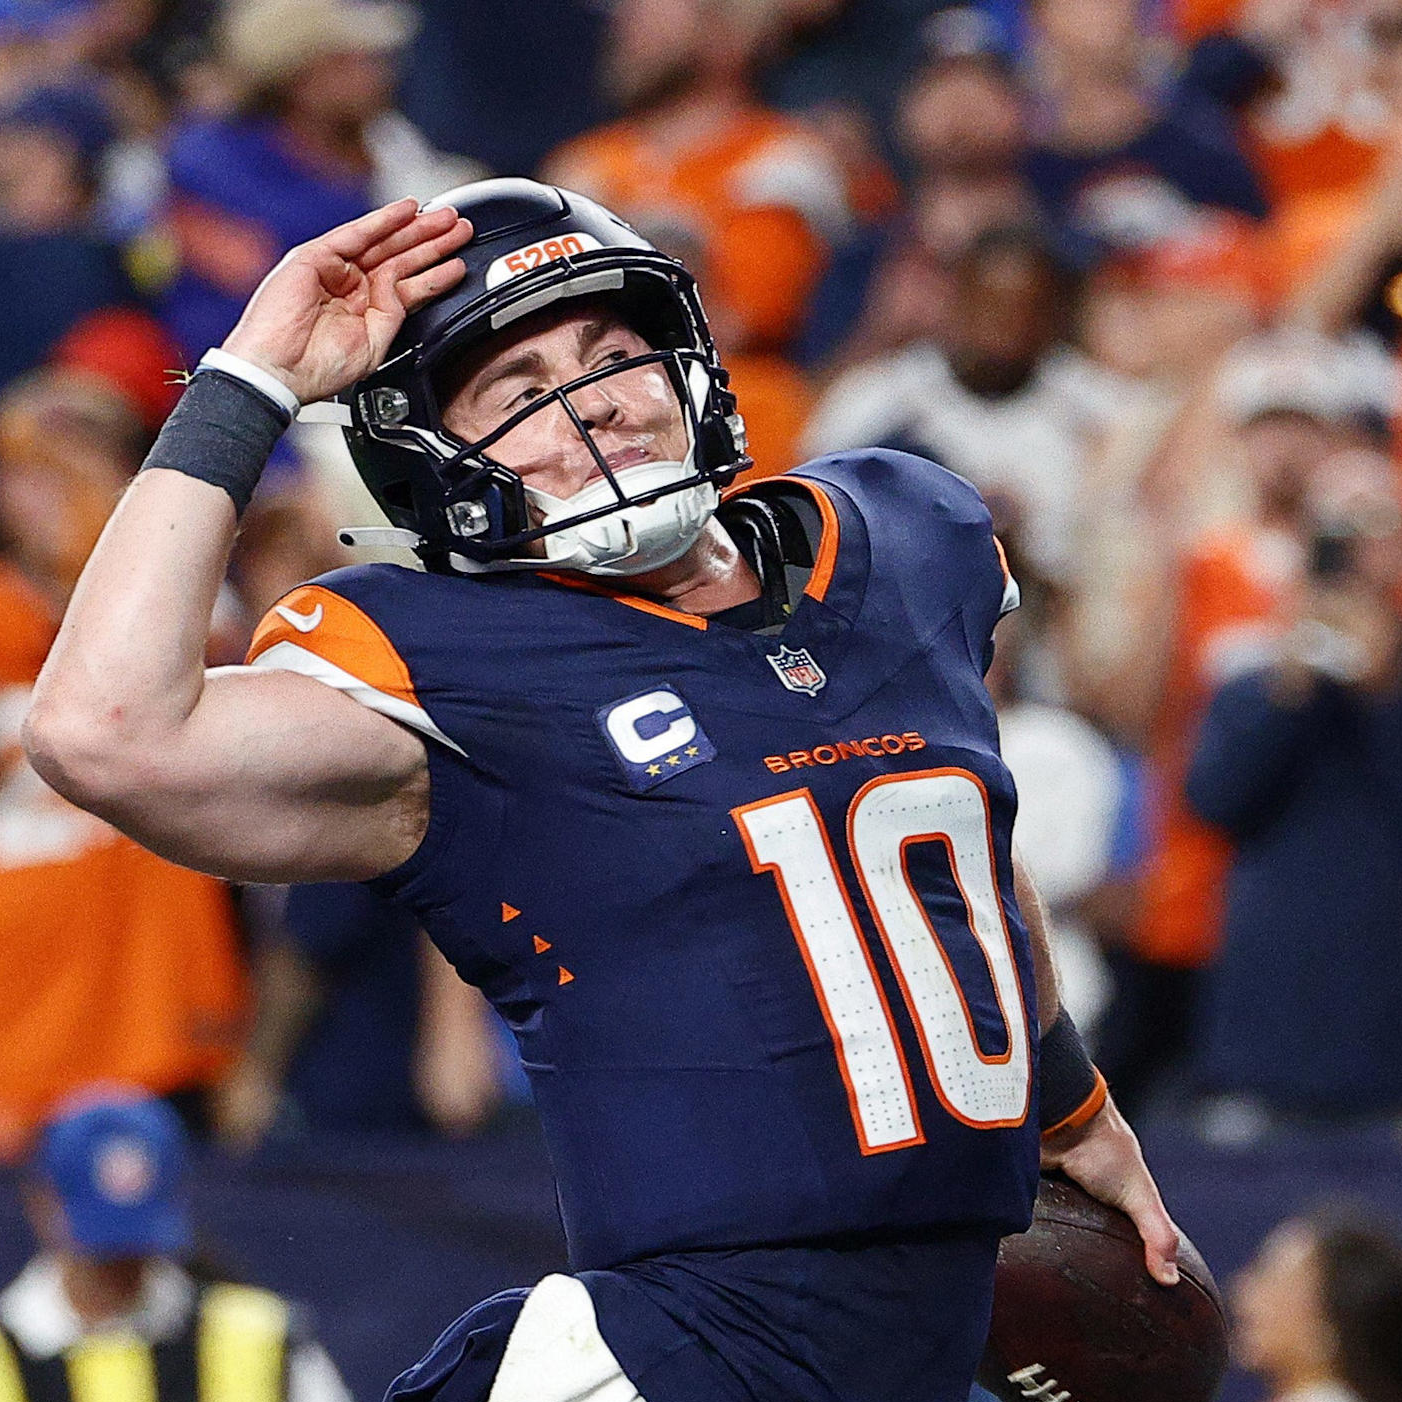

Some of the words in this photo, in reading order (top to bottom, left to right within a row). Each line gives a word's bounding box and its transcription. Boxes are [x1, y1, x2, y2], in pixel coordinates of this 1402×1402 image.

[505, 236, 584, 276] 5280
[607, 690, 697, 764] C
[763, 731, 927, 774] BRONCOS
[729, 766, 1032, 1157] 10
